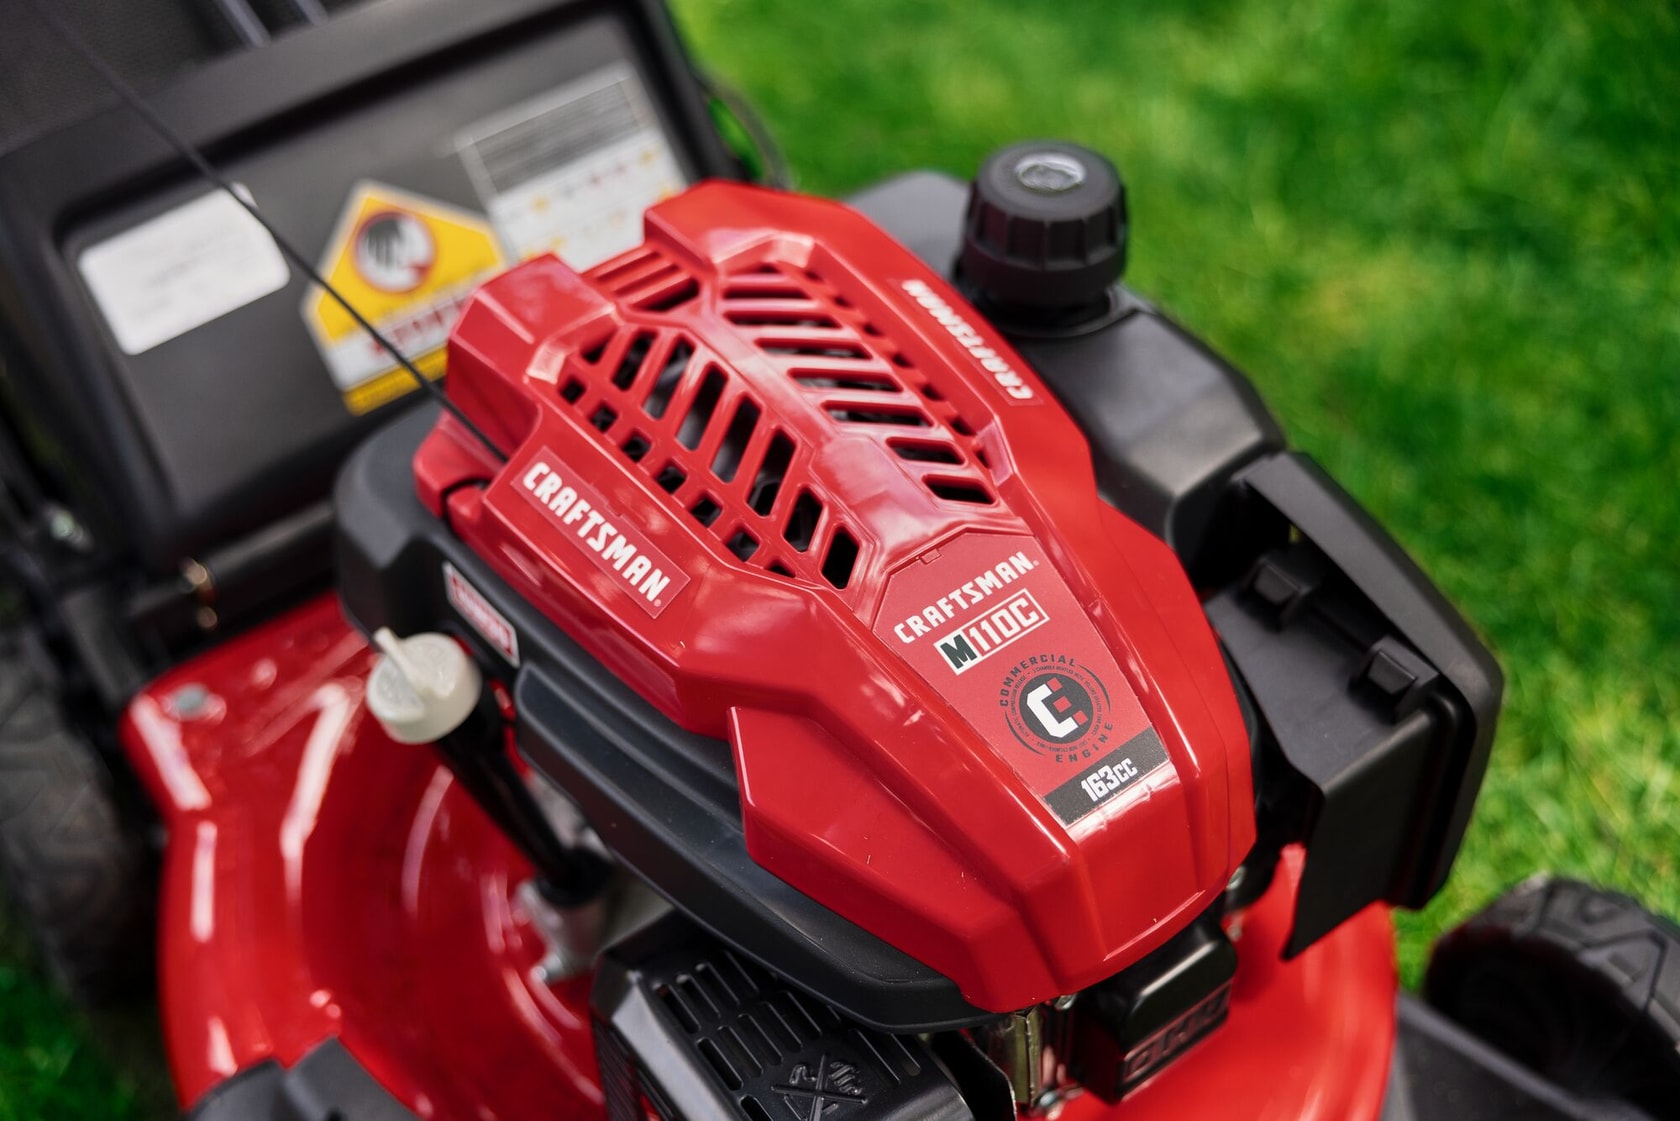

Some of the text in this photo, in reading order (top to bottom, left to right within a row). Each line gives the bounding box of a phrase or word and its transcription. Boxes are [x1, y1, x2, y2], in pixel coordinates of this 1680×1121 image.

[523, 462, 671, 603] CRAFTSMAN
[894, 551, 1035, 644] CRAFTSMAN
[940, 597, 1040, 669] M110C
[1000, 654, 1076, 707] COMMERCIAL
[1056, 722, 1113, 763] ENGINE
